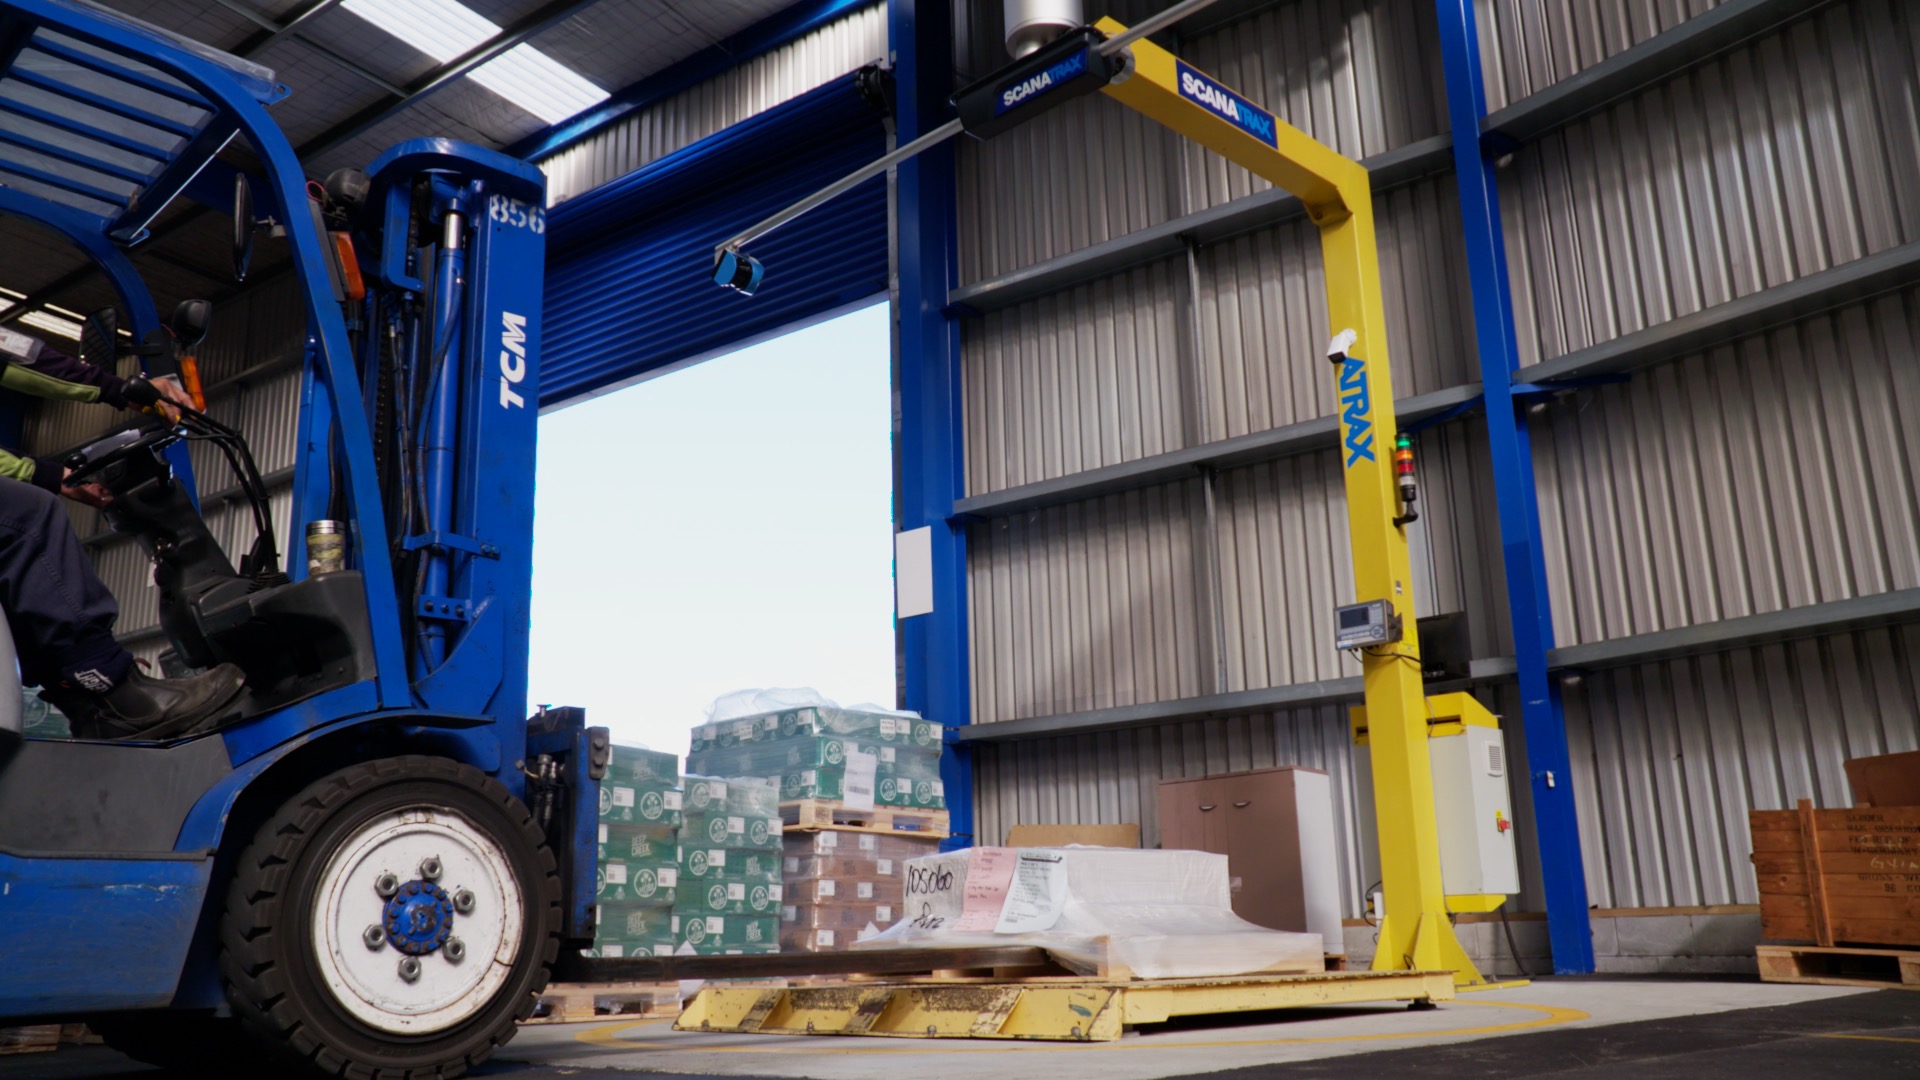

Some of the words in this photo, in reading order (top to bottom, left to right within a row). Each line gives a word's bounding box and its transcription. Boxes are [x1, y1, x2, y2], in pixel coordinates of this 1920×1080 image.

[1003, 54, 1083, 107] SCANATRAX
[1181, 71, 1273, 140] SCANATRAX
[490, 194, 545, 234] 856
[499, 311, 527, 409] TCM
[1339, 356, 1376, 469] ATRAX
[906, 864, 954, 897] 105060
